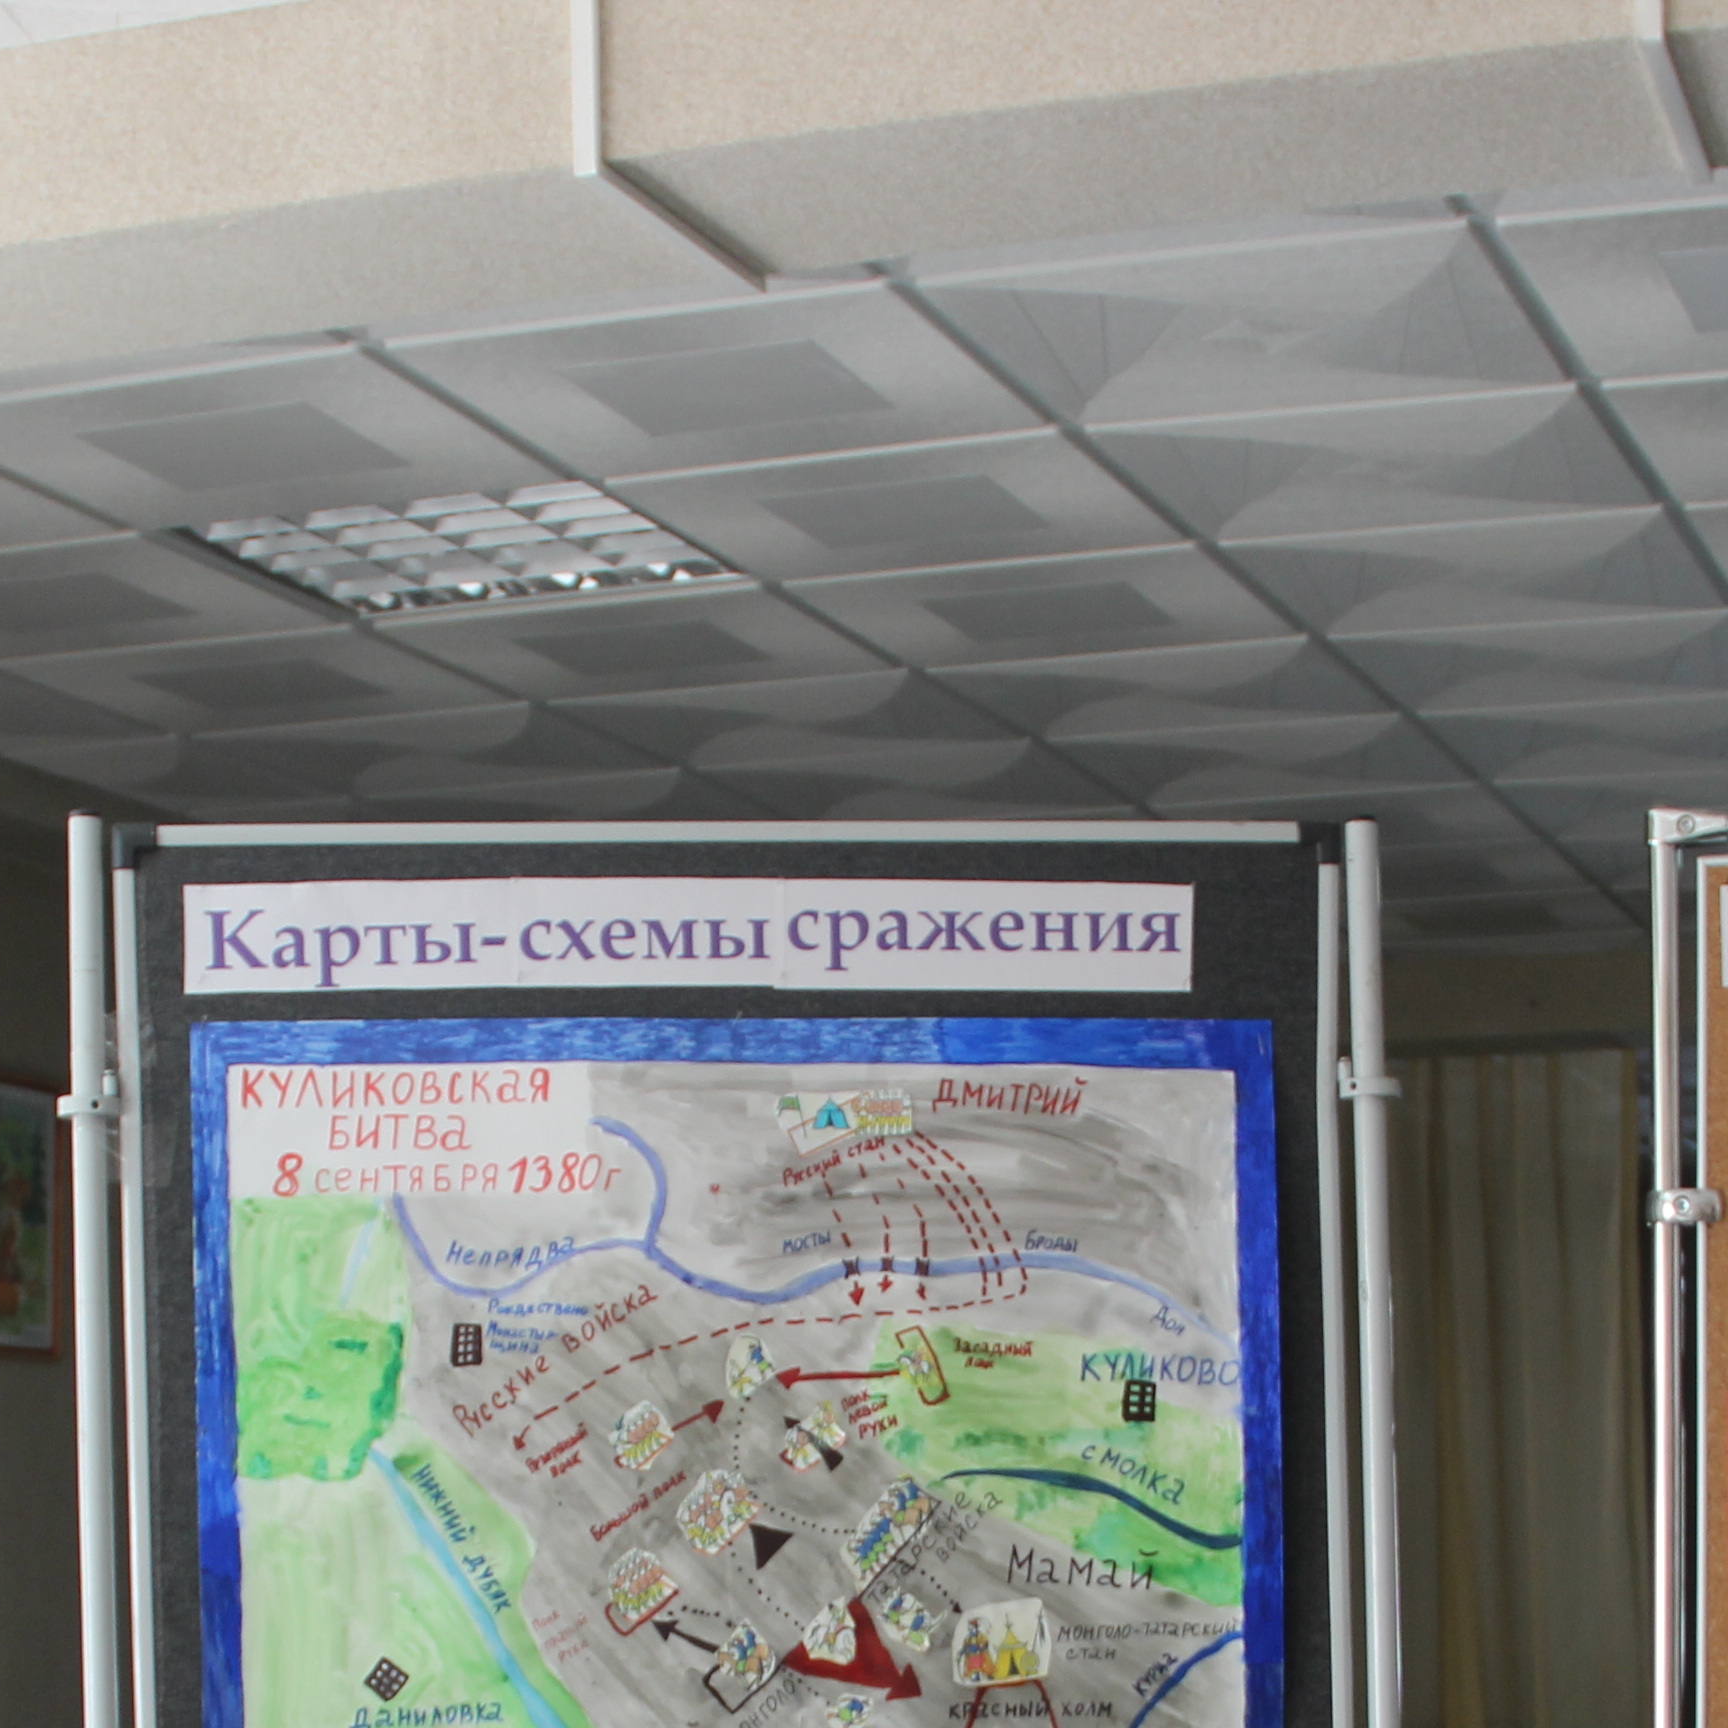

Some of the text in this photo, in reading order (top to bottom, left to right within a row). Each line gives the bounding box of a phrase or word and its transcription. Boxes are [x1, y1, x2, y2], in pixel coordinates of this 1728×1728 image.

[203, 907, 1181, 988] Карты-схемы сражения
[931, 1076, 1088, 1115] ДМИТРИЙ
[272, 1152, 304, 1198] 8
[1079, 1352, 1244, 1388] КУЛИКОВО
